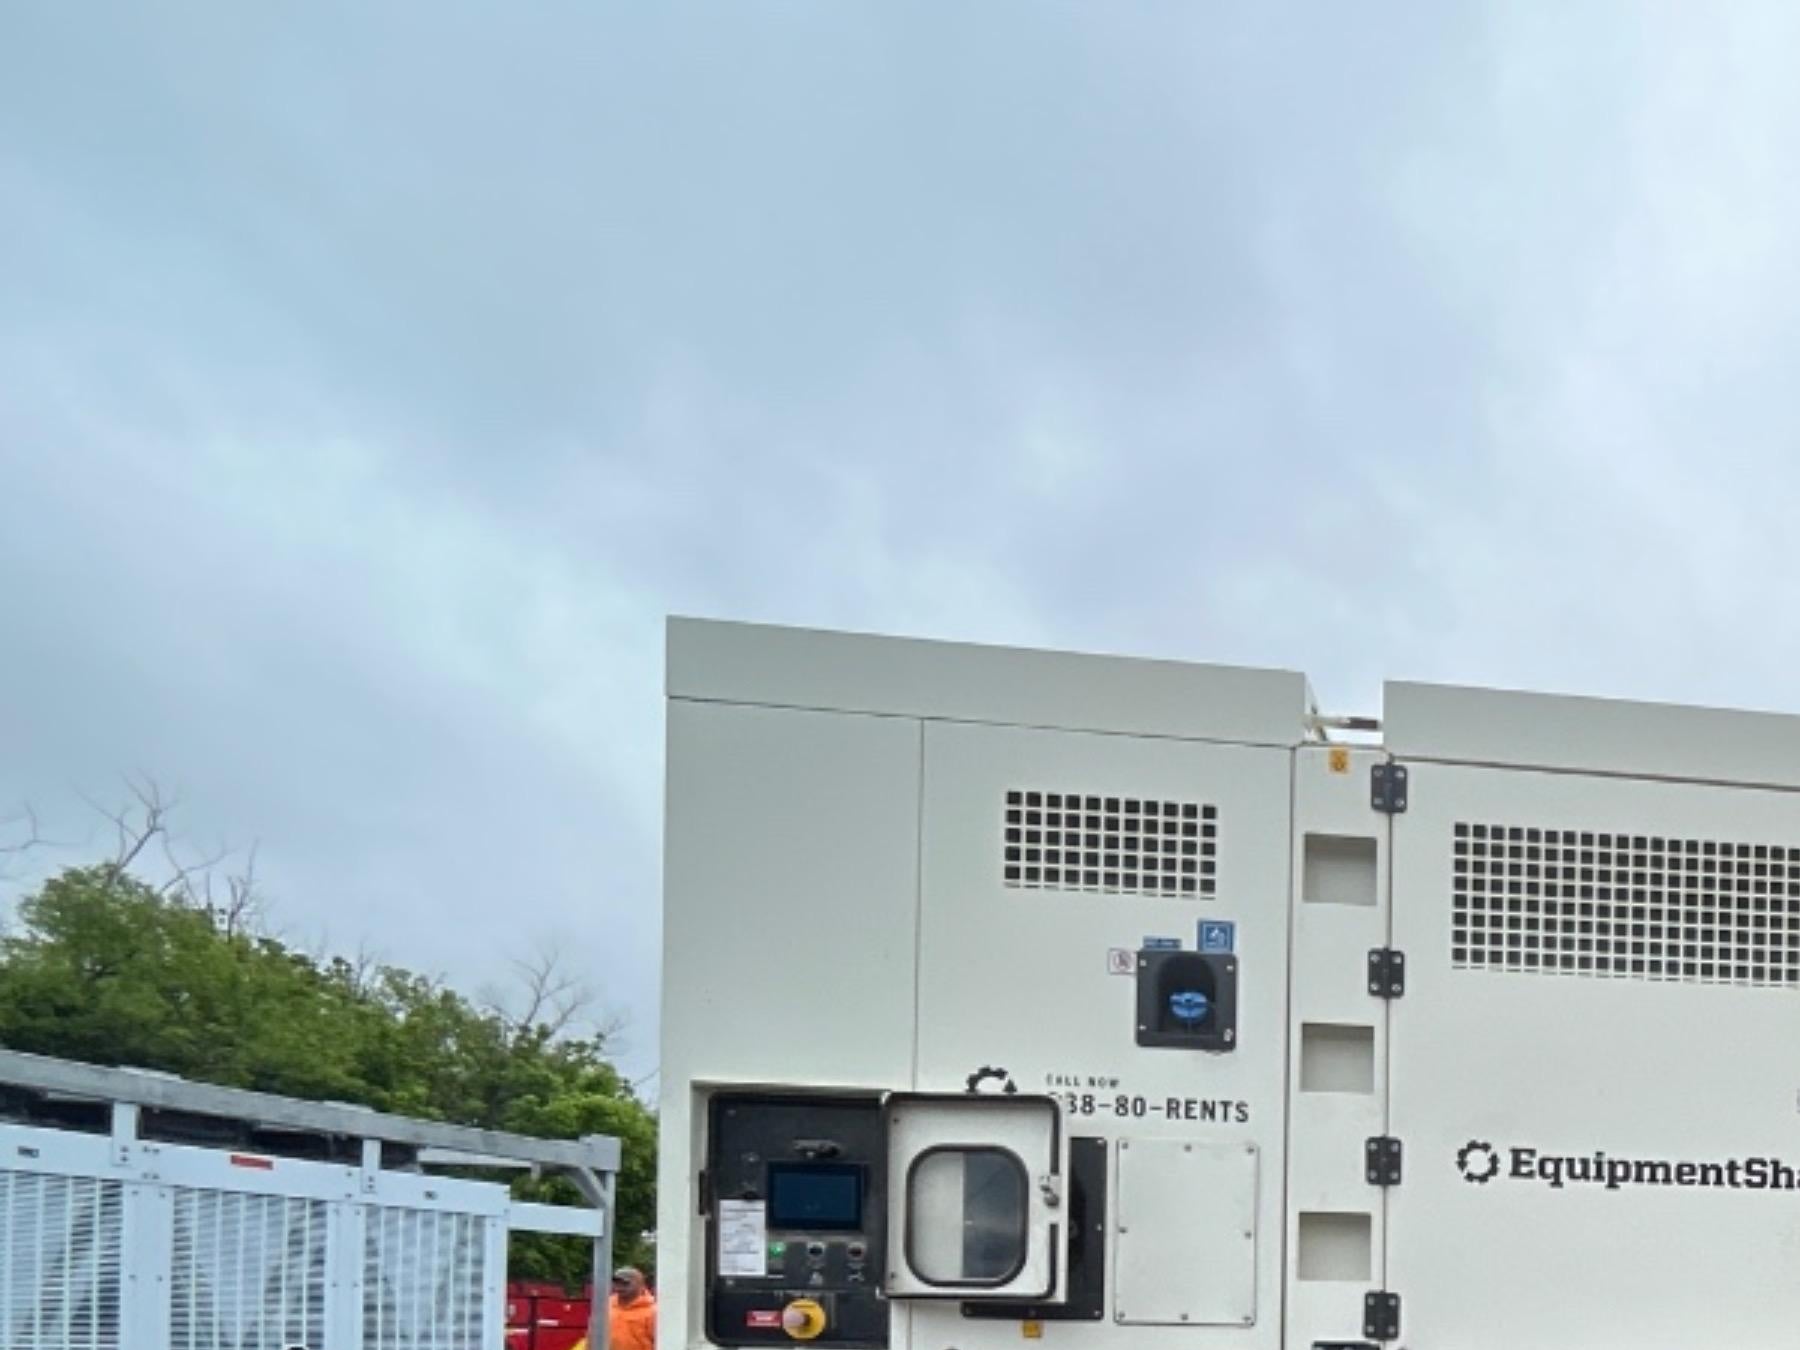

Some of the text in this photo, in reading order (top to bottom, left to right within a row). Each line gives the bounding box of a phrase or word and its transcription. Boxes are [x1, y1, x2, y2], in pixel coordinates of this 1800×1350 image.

[1045, 1073, 1120, 1089] CALL NOW
[1048, 1091, 1249, 1124] 8-80-RENTS
